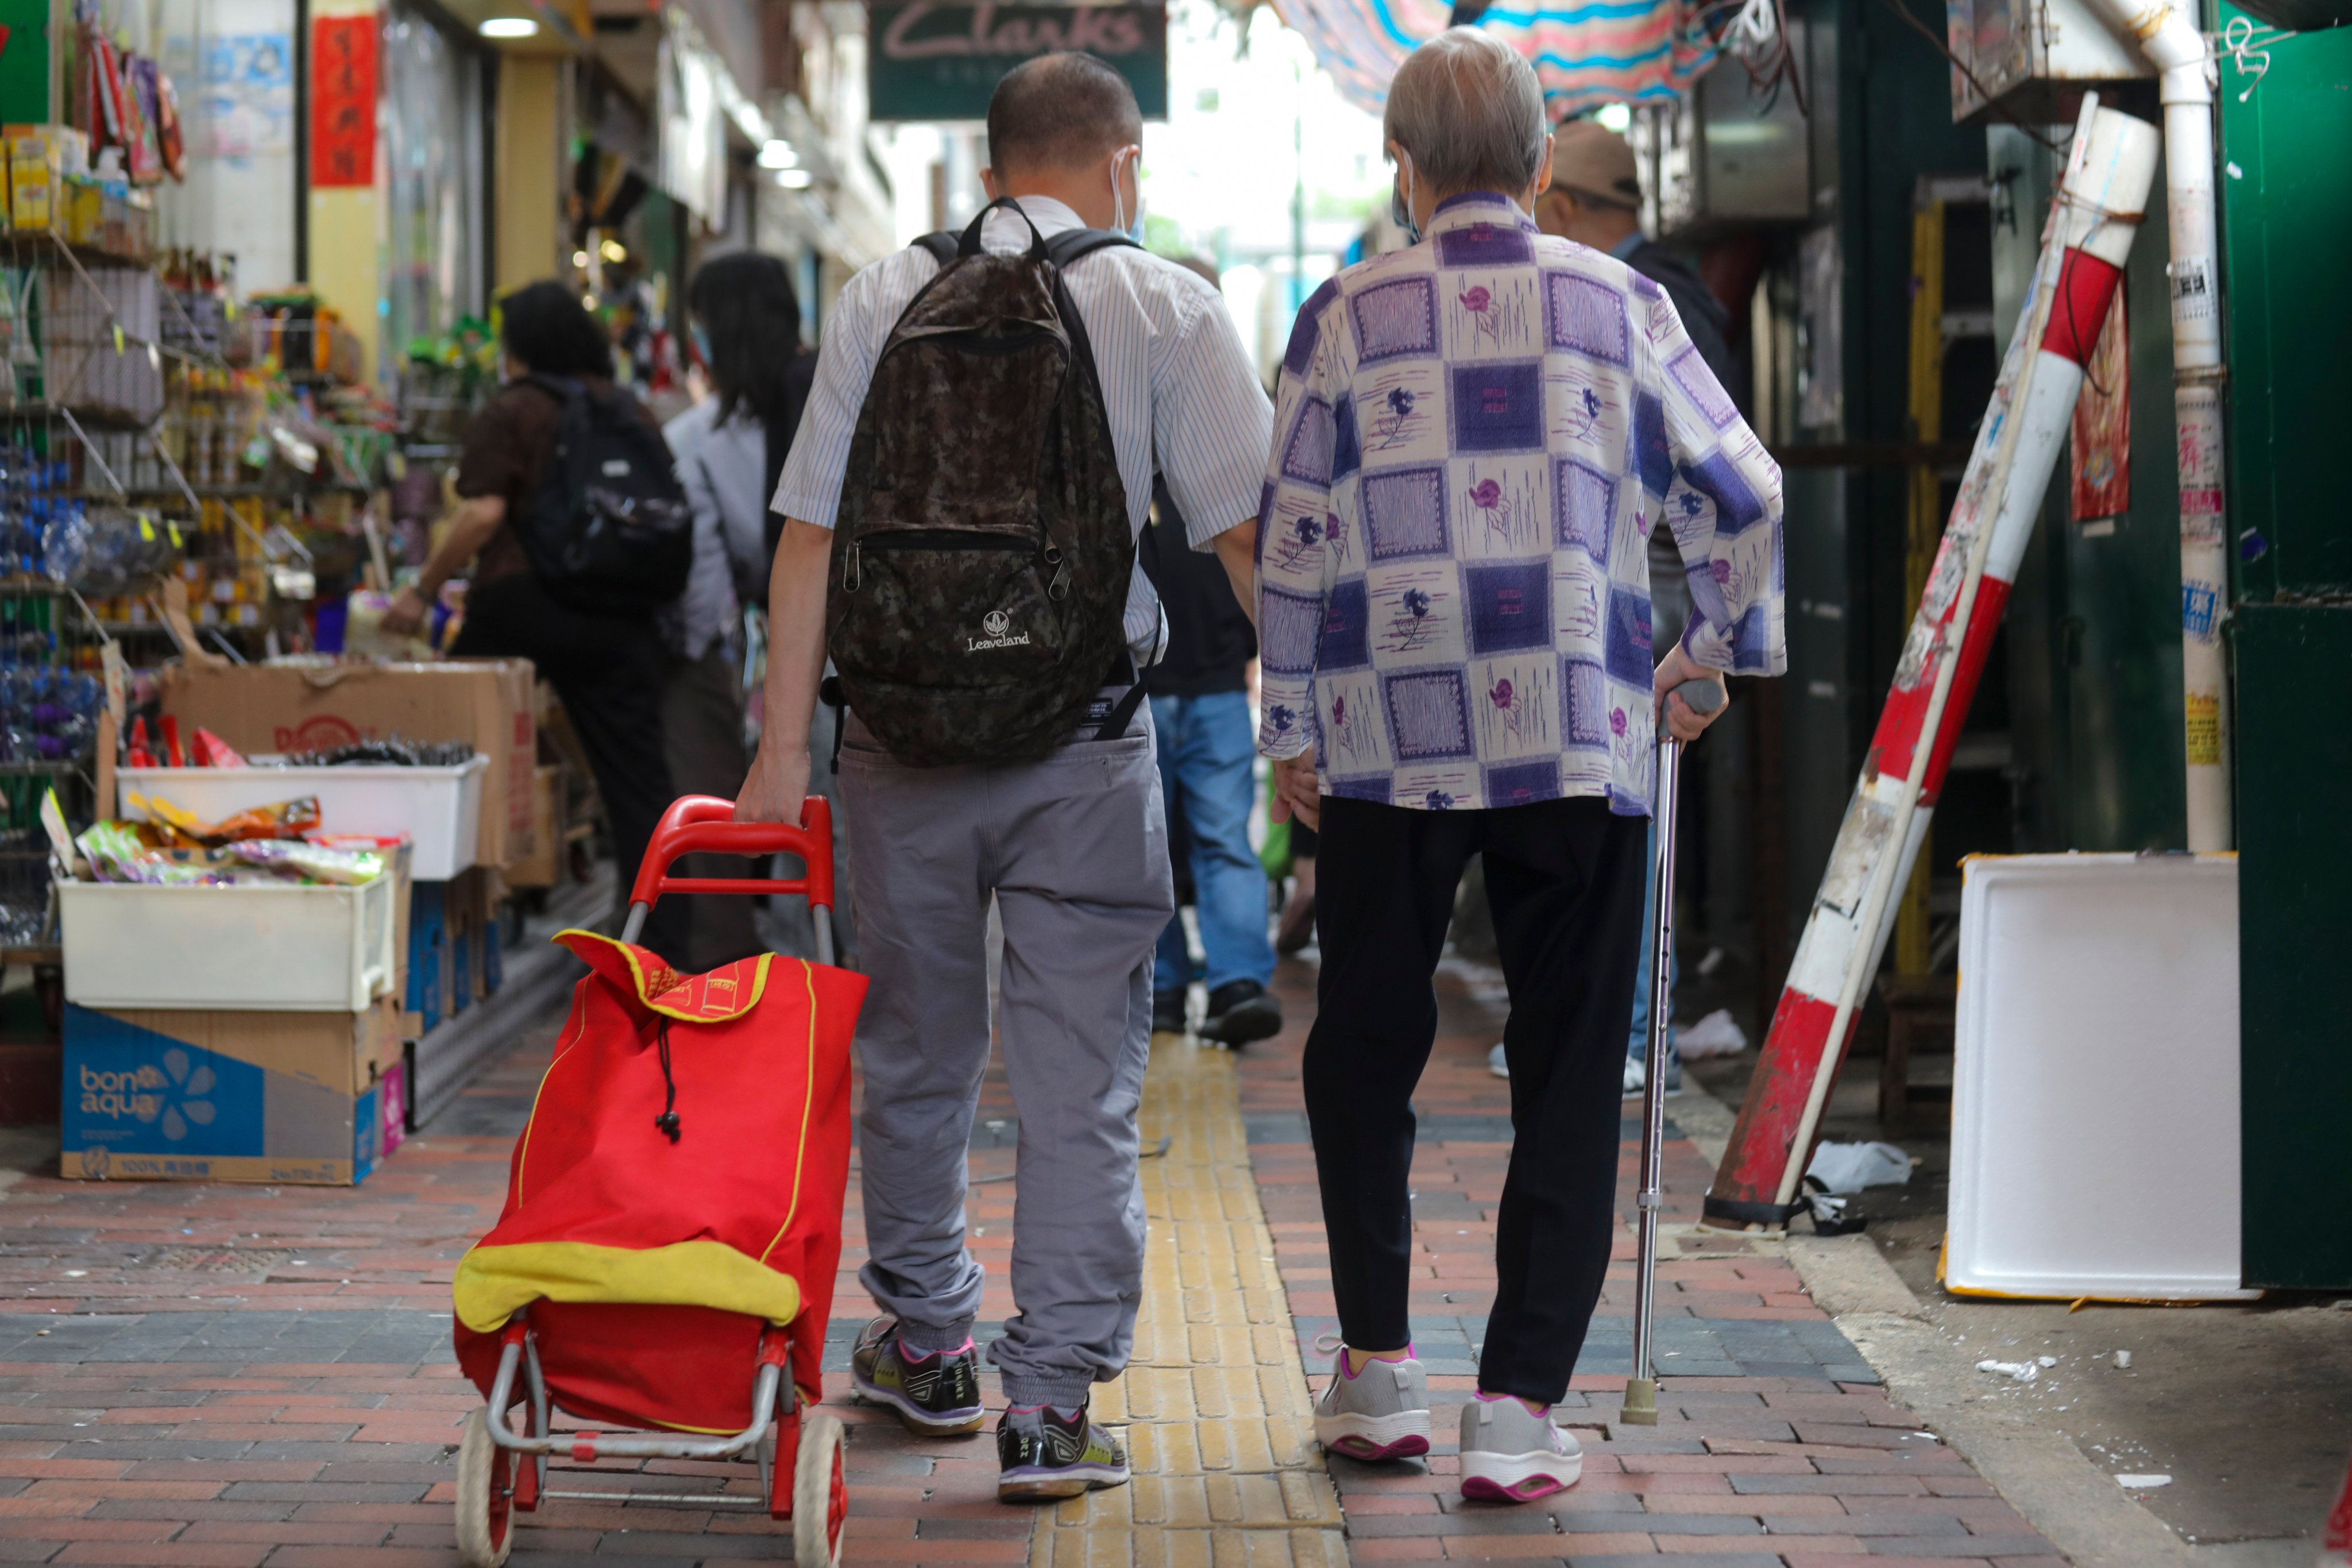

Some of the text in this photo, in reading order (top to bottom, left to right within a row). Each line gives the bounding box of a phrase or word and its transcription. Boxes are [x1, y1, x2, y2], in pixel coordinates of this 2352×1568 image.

[967, 631, 1030, 651] Leaveland
[80, 1063, 138, 1092] bon
[80, 1092, 156, 1120] aqua
